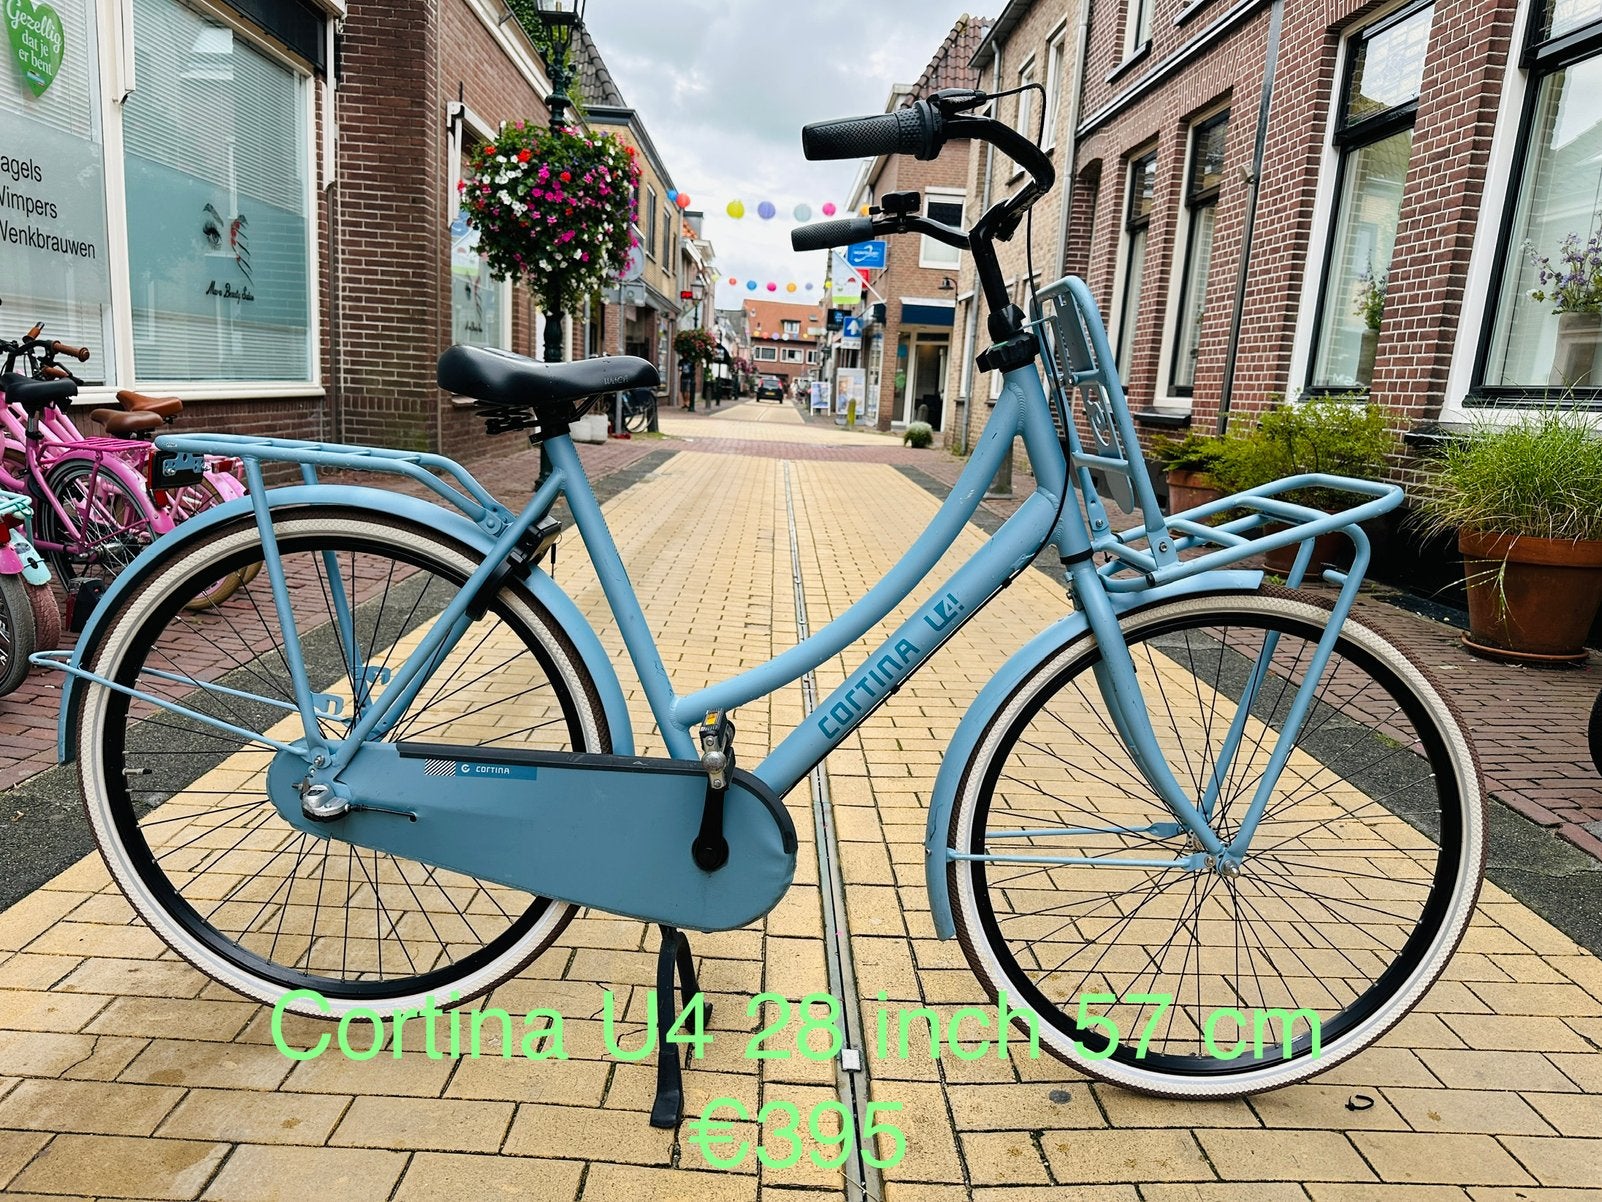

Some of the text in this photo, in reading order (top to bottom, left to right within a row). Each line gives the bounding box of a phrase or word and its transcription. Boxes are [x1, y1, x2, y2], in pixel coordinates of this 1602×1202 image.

[7, 0, 62, 53] Gezellig
[22, 30, 49, 58] dat je
[18, 48, 52, 76] er bent
[817, 638, 921, 740] CORTINA
[475, 765, 511, 775] CORTINA
